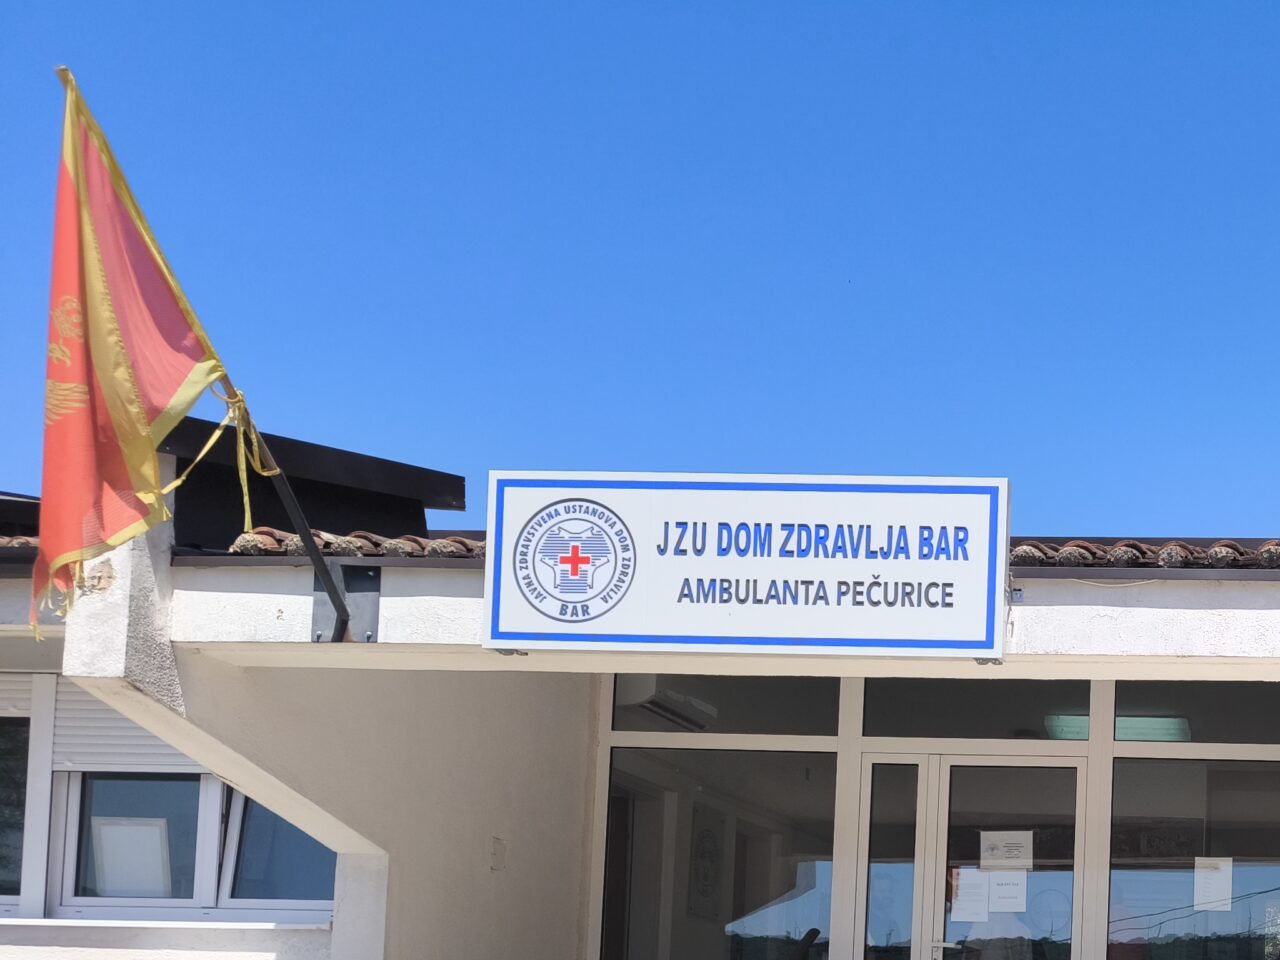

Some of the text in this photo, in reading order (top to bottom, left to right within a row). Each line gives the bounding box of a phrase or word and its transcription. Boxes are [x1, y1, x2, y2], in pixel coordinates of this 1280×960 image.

[519, 504, 632, 604] JAVNA ZDRAVSTVENA USTANOVA DOM ZDRAVLJA
[656, 521, 970, 561] JZU DOM ZDRAVLJA BAR
[677, 574, 955, 608] AMBULANTA PEČURICE
[559, 603, 591, 618] BAR
